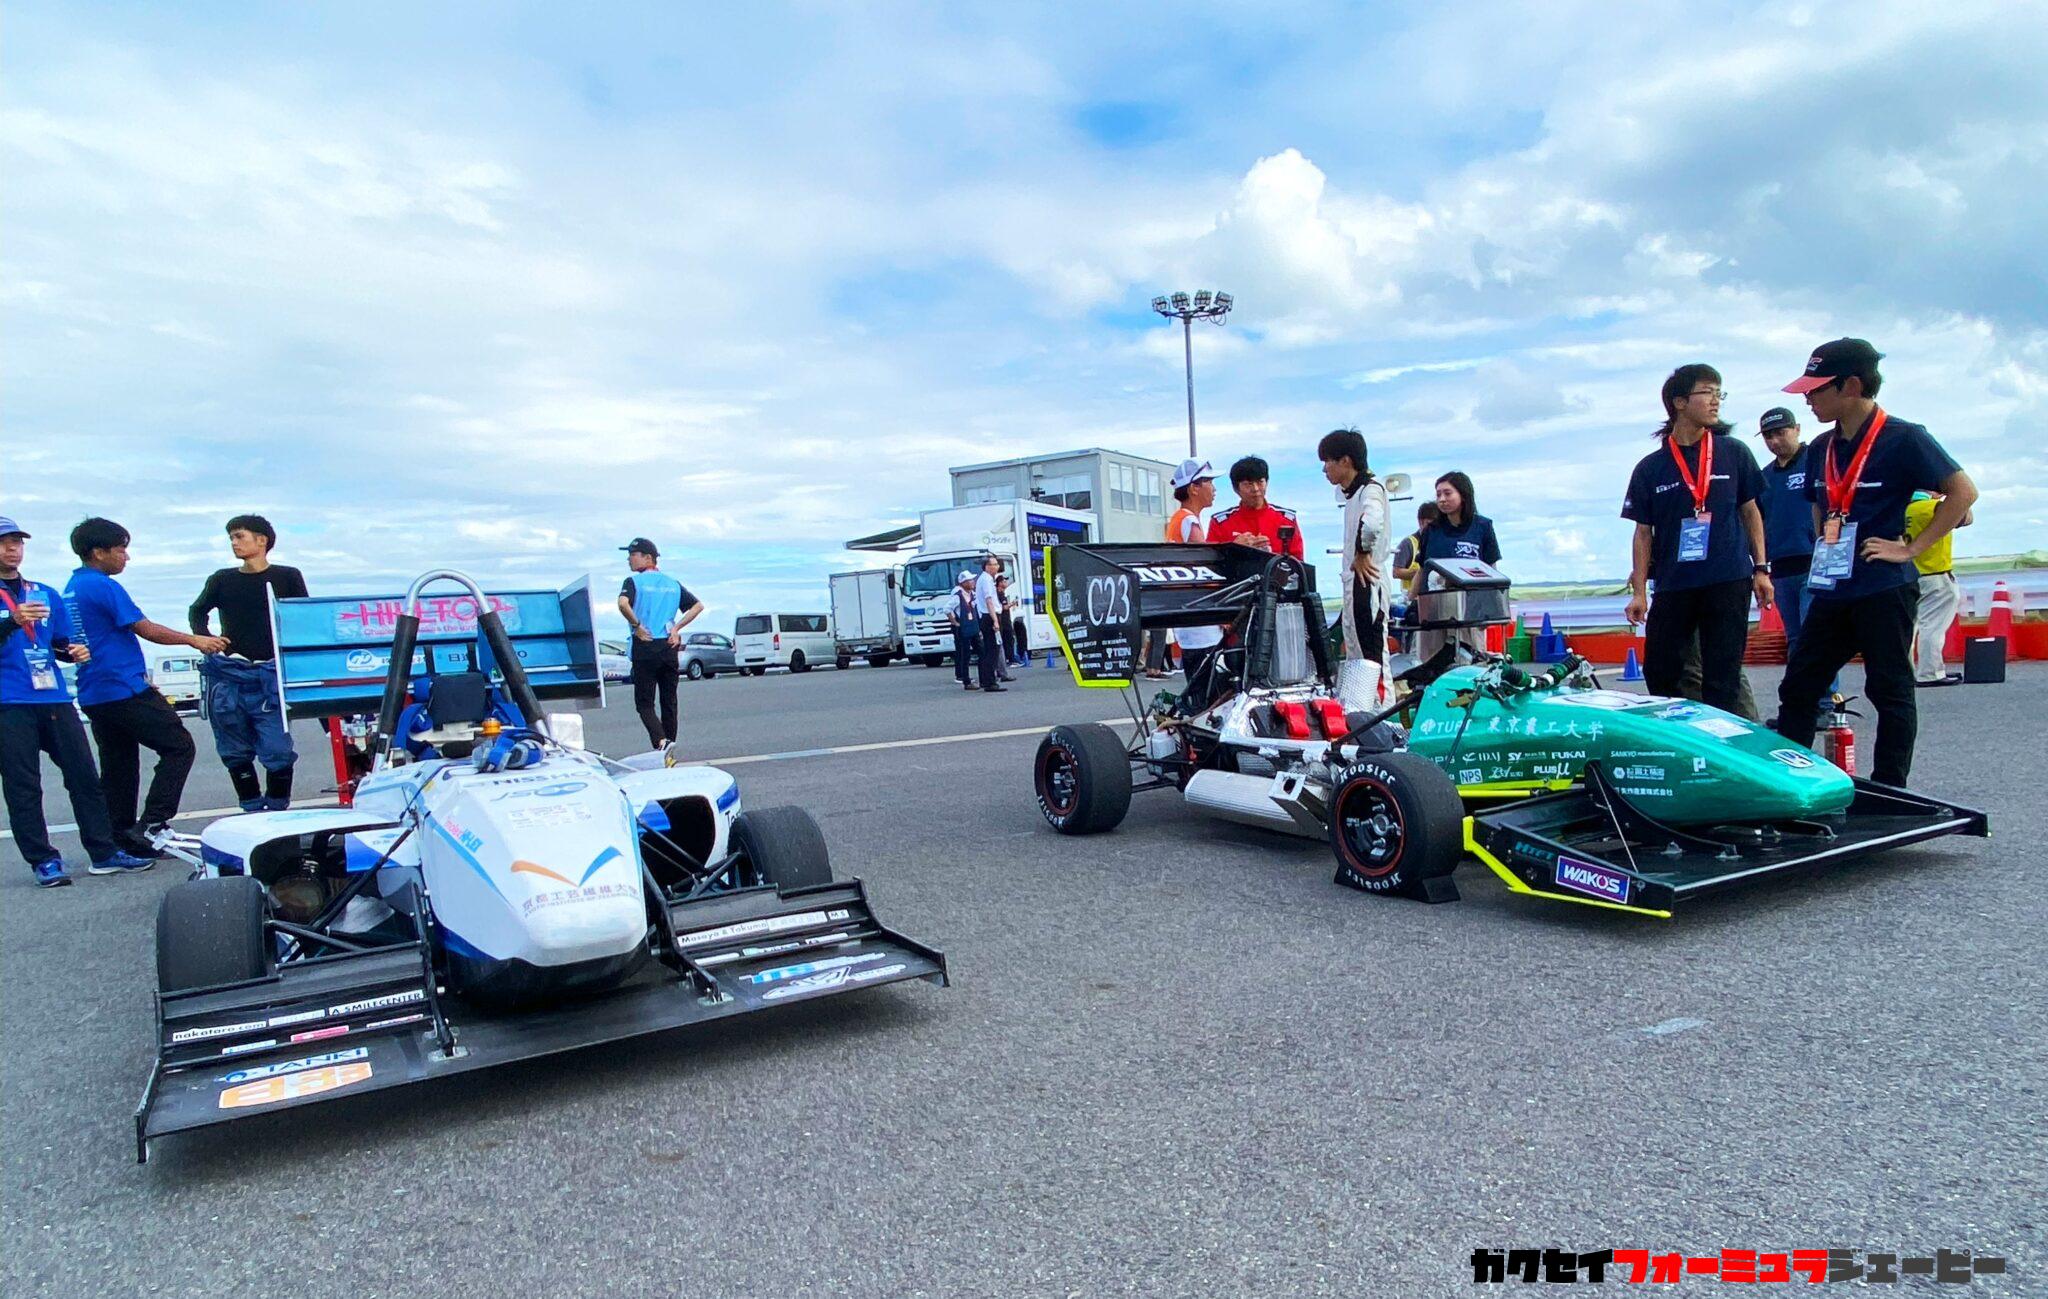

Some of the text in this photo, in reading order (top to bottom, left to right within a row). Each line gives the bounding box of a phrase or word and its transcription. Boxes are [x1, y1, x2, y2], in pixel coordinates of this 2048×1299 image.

[1132, 566, 1227, 582] NDA
[1088, 574, 1130, 626] C23
[1478, 752, 1501, 762] IDAJ
[1551, 751, 1586, 759] FUKAI
[1461, 771, 1481, 783] NPS
